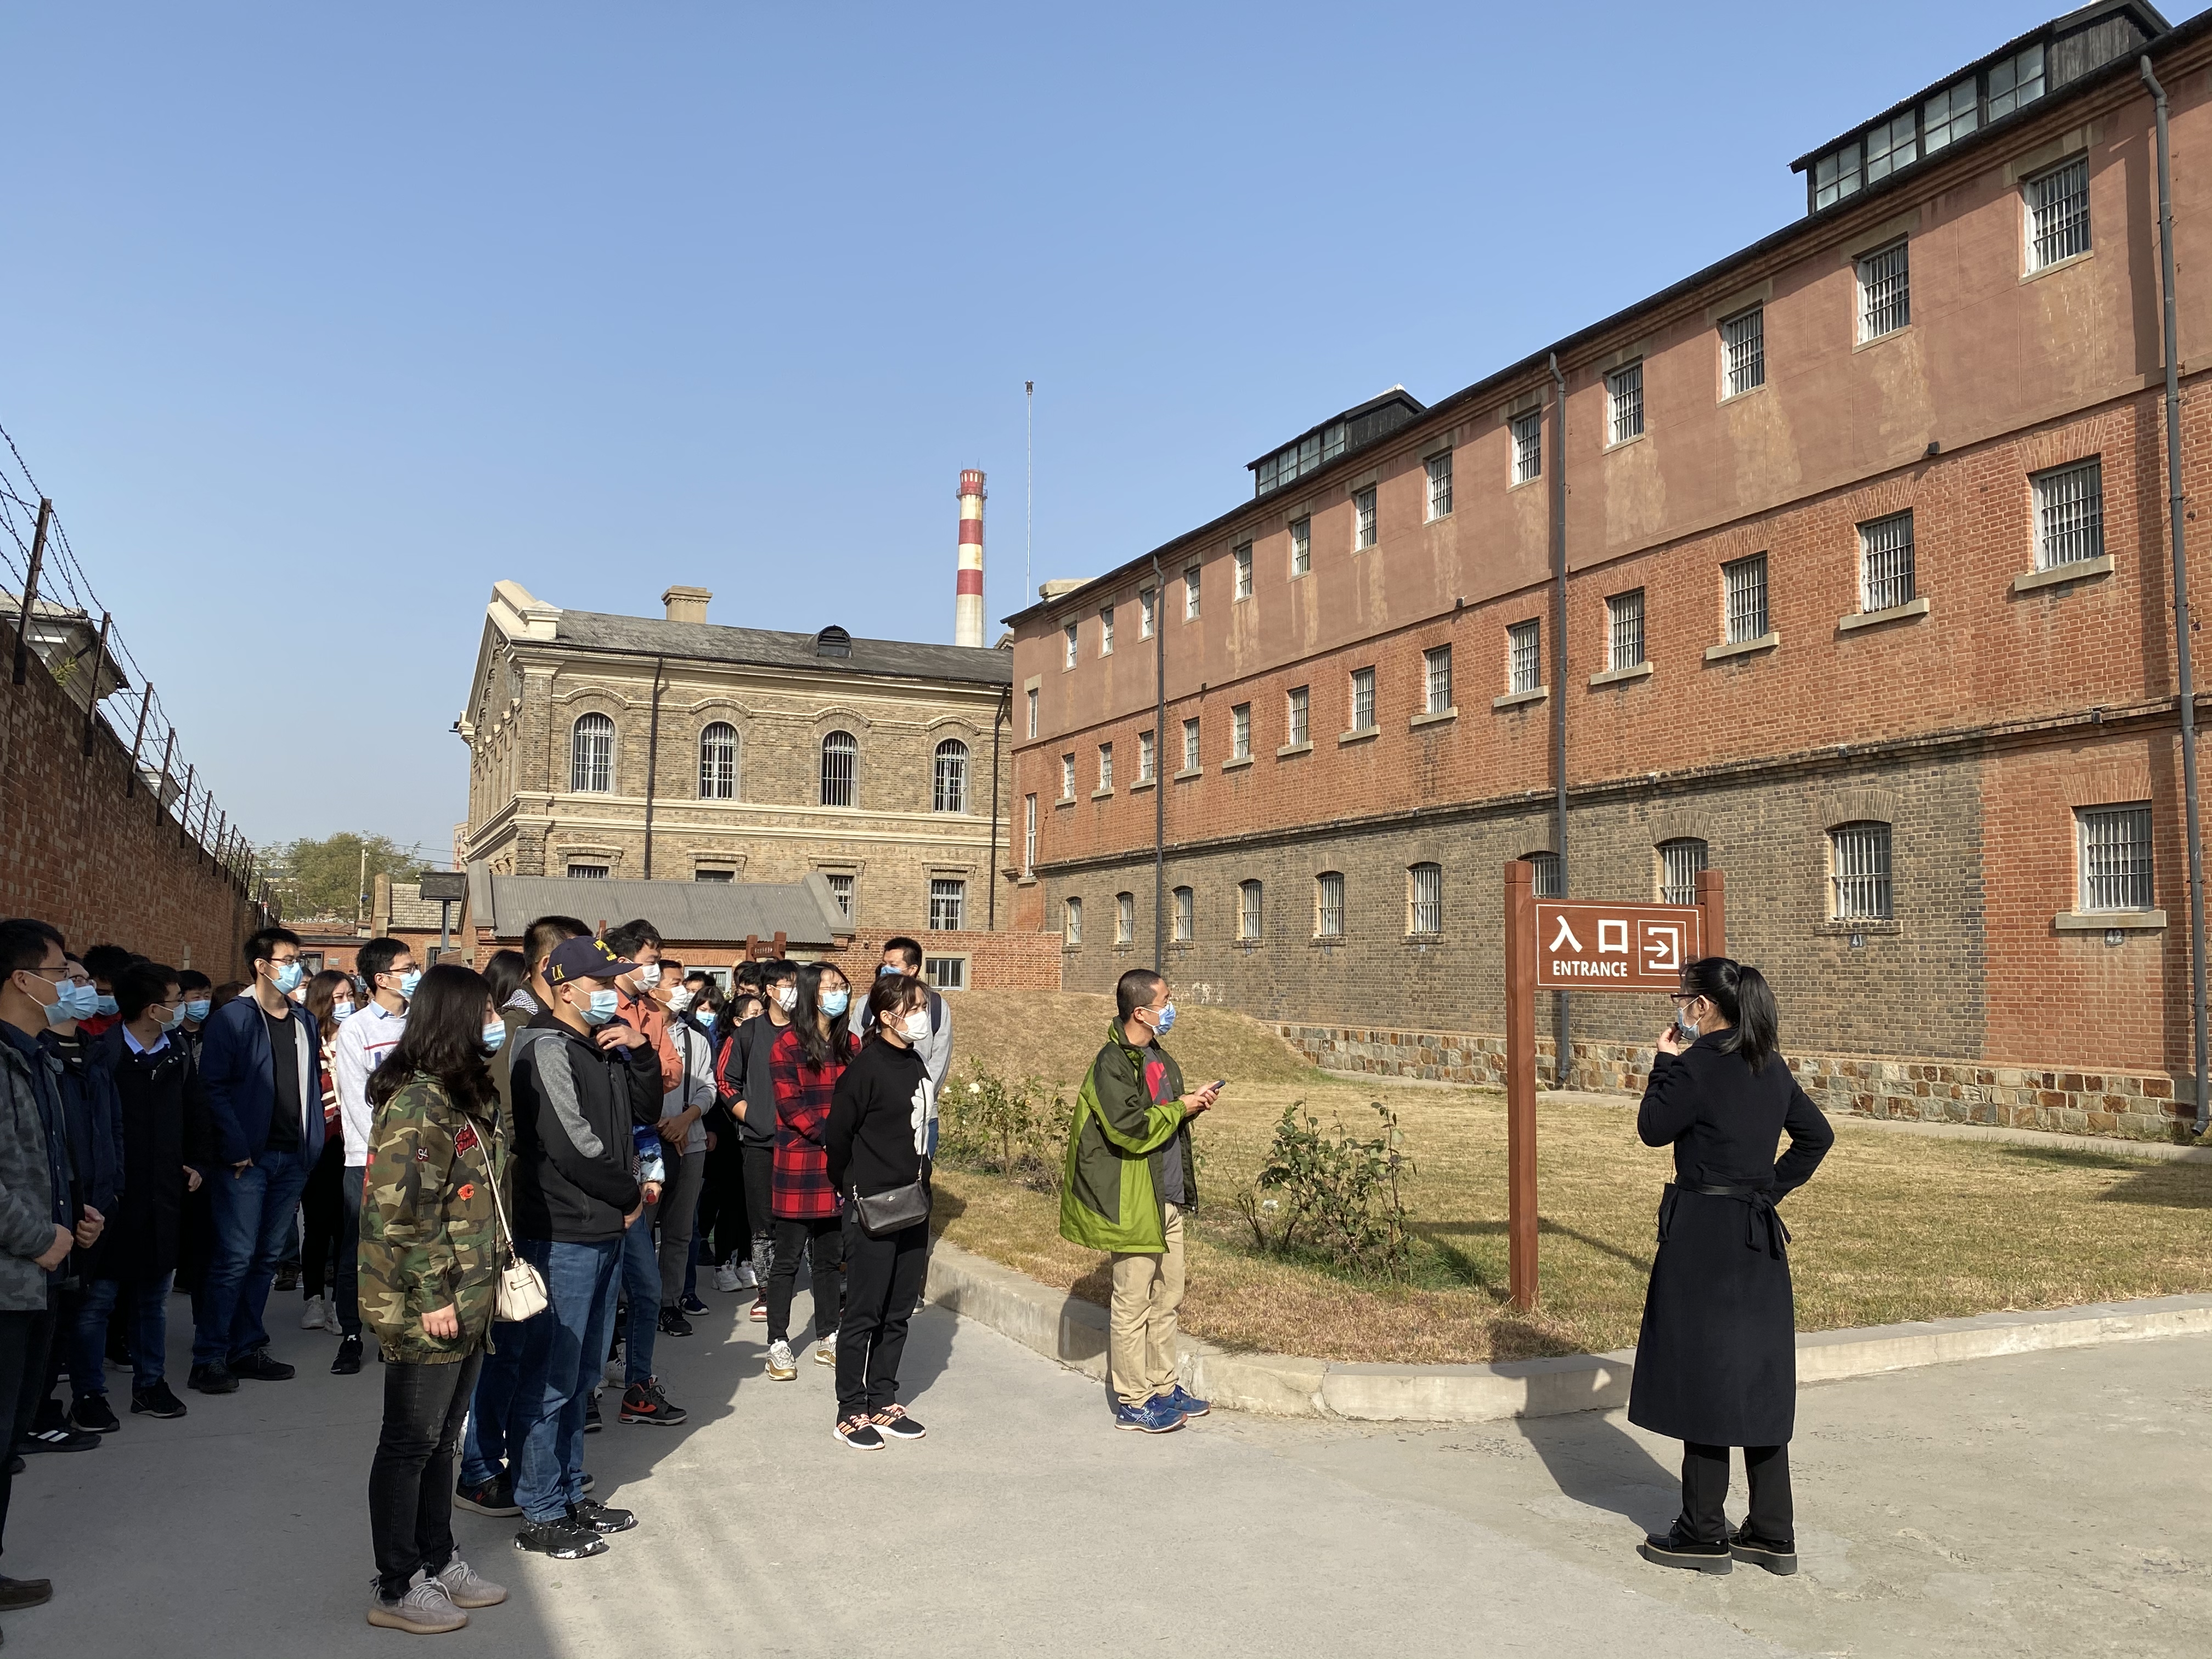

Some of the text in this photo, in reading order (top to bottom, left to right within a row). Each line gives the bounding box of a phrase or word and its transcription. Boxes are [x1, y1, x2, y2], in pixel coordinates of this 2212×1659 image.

[1549, 915, 1628, 953] 入口
[1852, 934, 1863, 946] 41
[2107, 930, 2122, 943] 42
[1553, 961, 1628, 977] ENTRANCE
